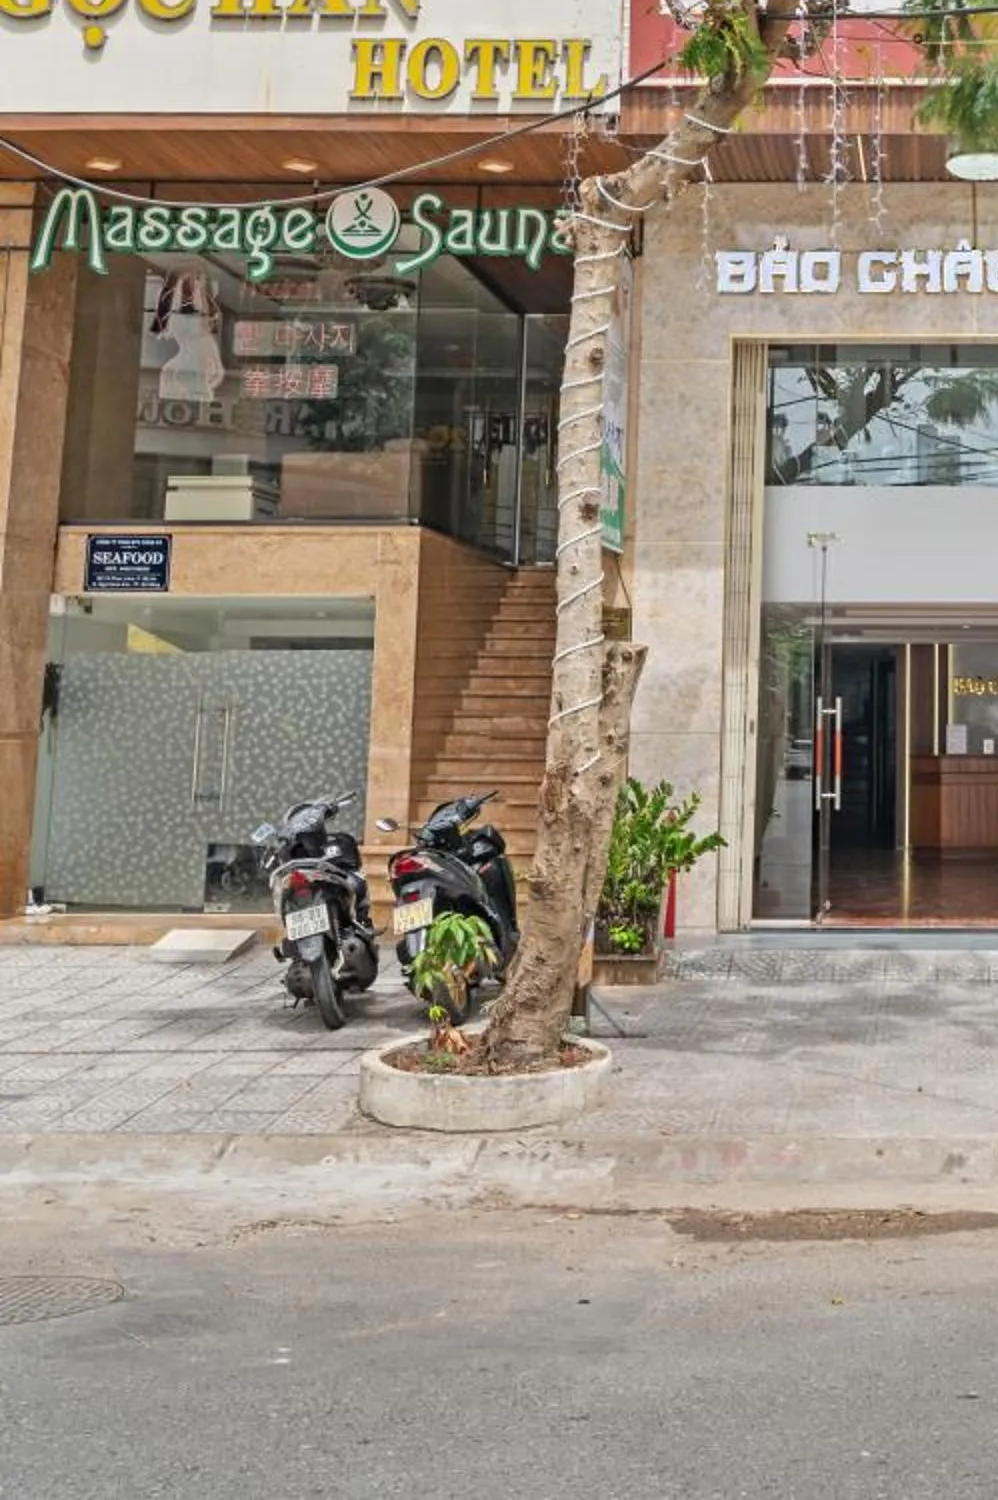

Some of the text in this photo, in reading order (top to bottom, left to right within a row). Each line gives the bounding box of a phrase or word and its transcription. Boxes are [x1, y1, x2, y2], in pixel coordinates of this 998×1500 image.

[349, 37, 608, 101] HOTEL
[31, 187, 318, 280] Massage
[714, 236, 841, 293] BẢO
[93, 551, 164, 565] SEAFOOD
